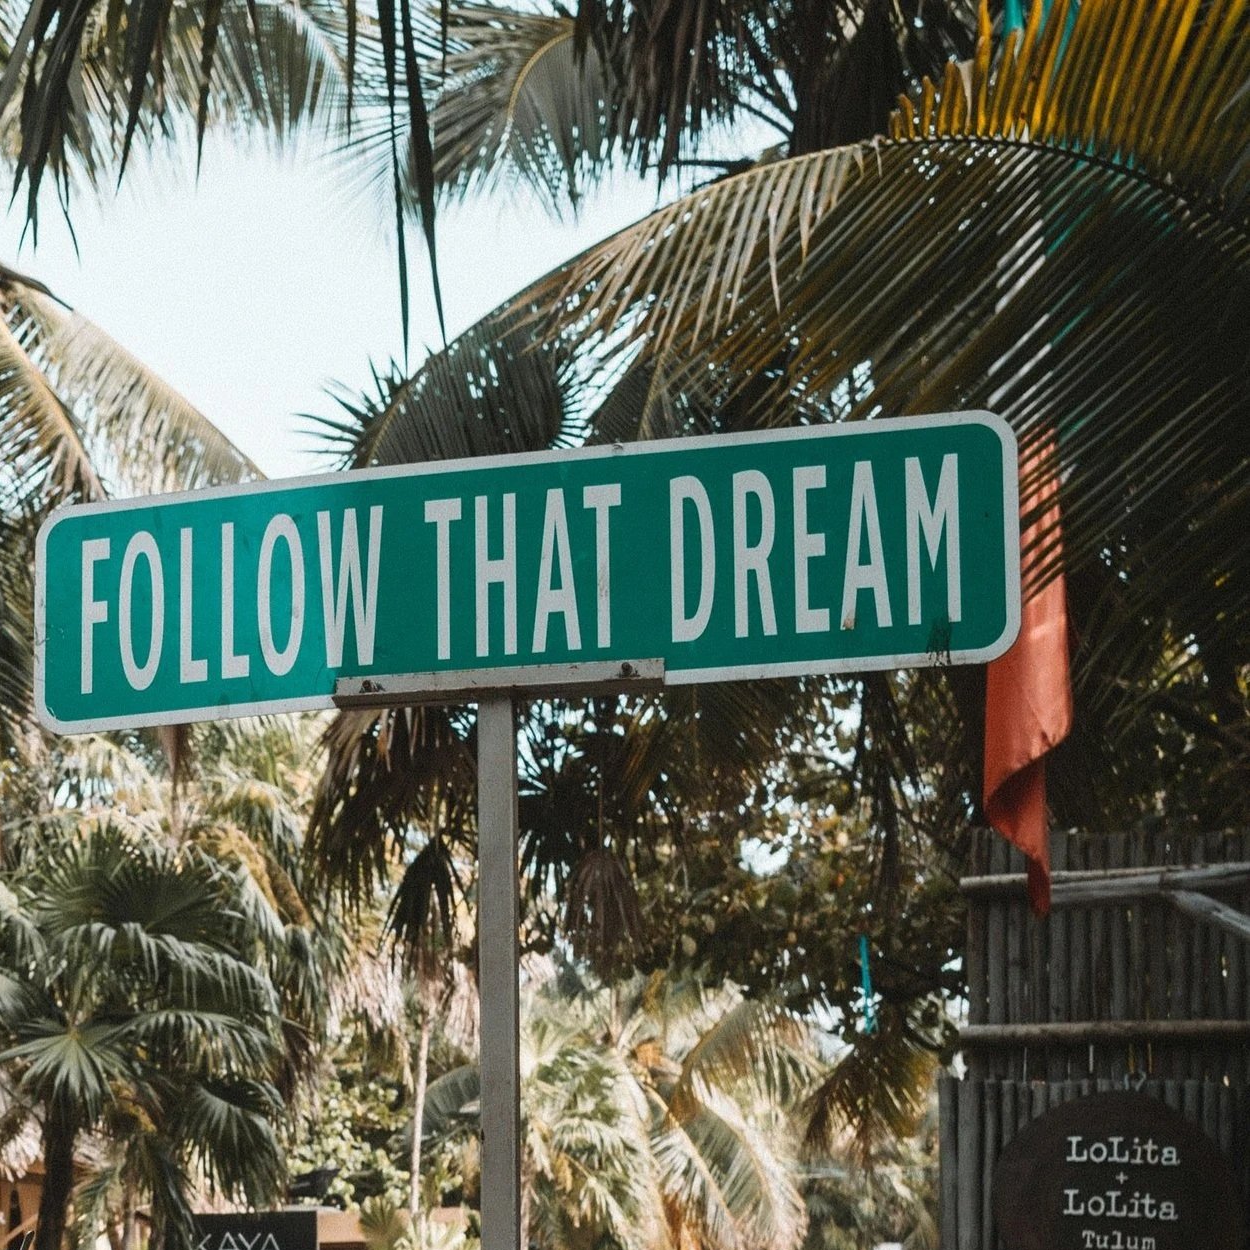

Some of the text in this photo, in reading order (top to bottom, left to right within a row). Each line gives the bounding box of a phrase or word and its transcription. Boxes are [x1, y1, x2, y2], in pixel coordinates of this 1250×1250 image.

[79, 453, 962, 696] FOLLOW THAT DREAM
[1066, 1135, 1180, 1166] LoLita
[1063, 1189, 1178, 1221] LoLita
[1082, 1230, 1156, 1250] Tulum
